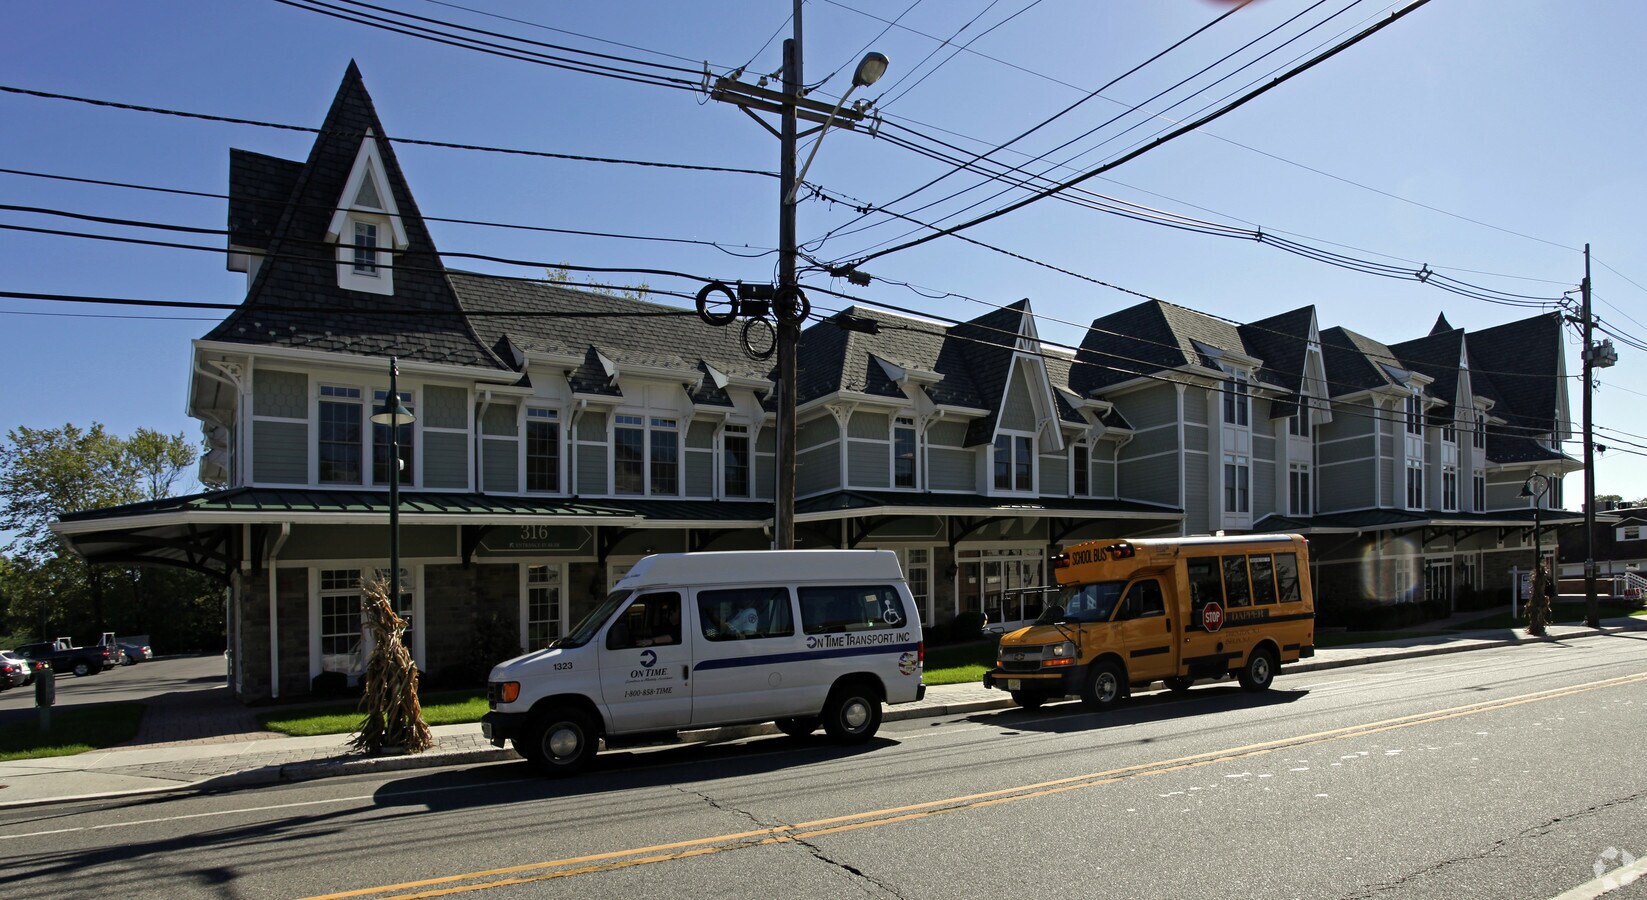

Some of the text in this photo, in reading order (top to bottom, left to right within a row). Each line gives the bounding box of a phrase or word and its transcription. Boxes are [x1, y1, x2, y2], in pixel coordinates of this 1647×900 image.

[520, 525, 548, 540] 316
[1072, 547, 1107, 565] SCHOOL BUS
[1205, 611, 1221, 623] STOP
[824, 634, 844, 648] TIME
[845, 633, 895, 646] TRANSPORT,
[896, 632, 910, 642] INC
[553, 662, 573, 671] 1323
[630, 668, 668, 679] ON TIME
[624, 686, 673, 698] 1-800-858-TIME
